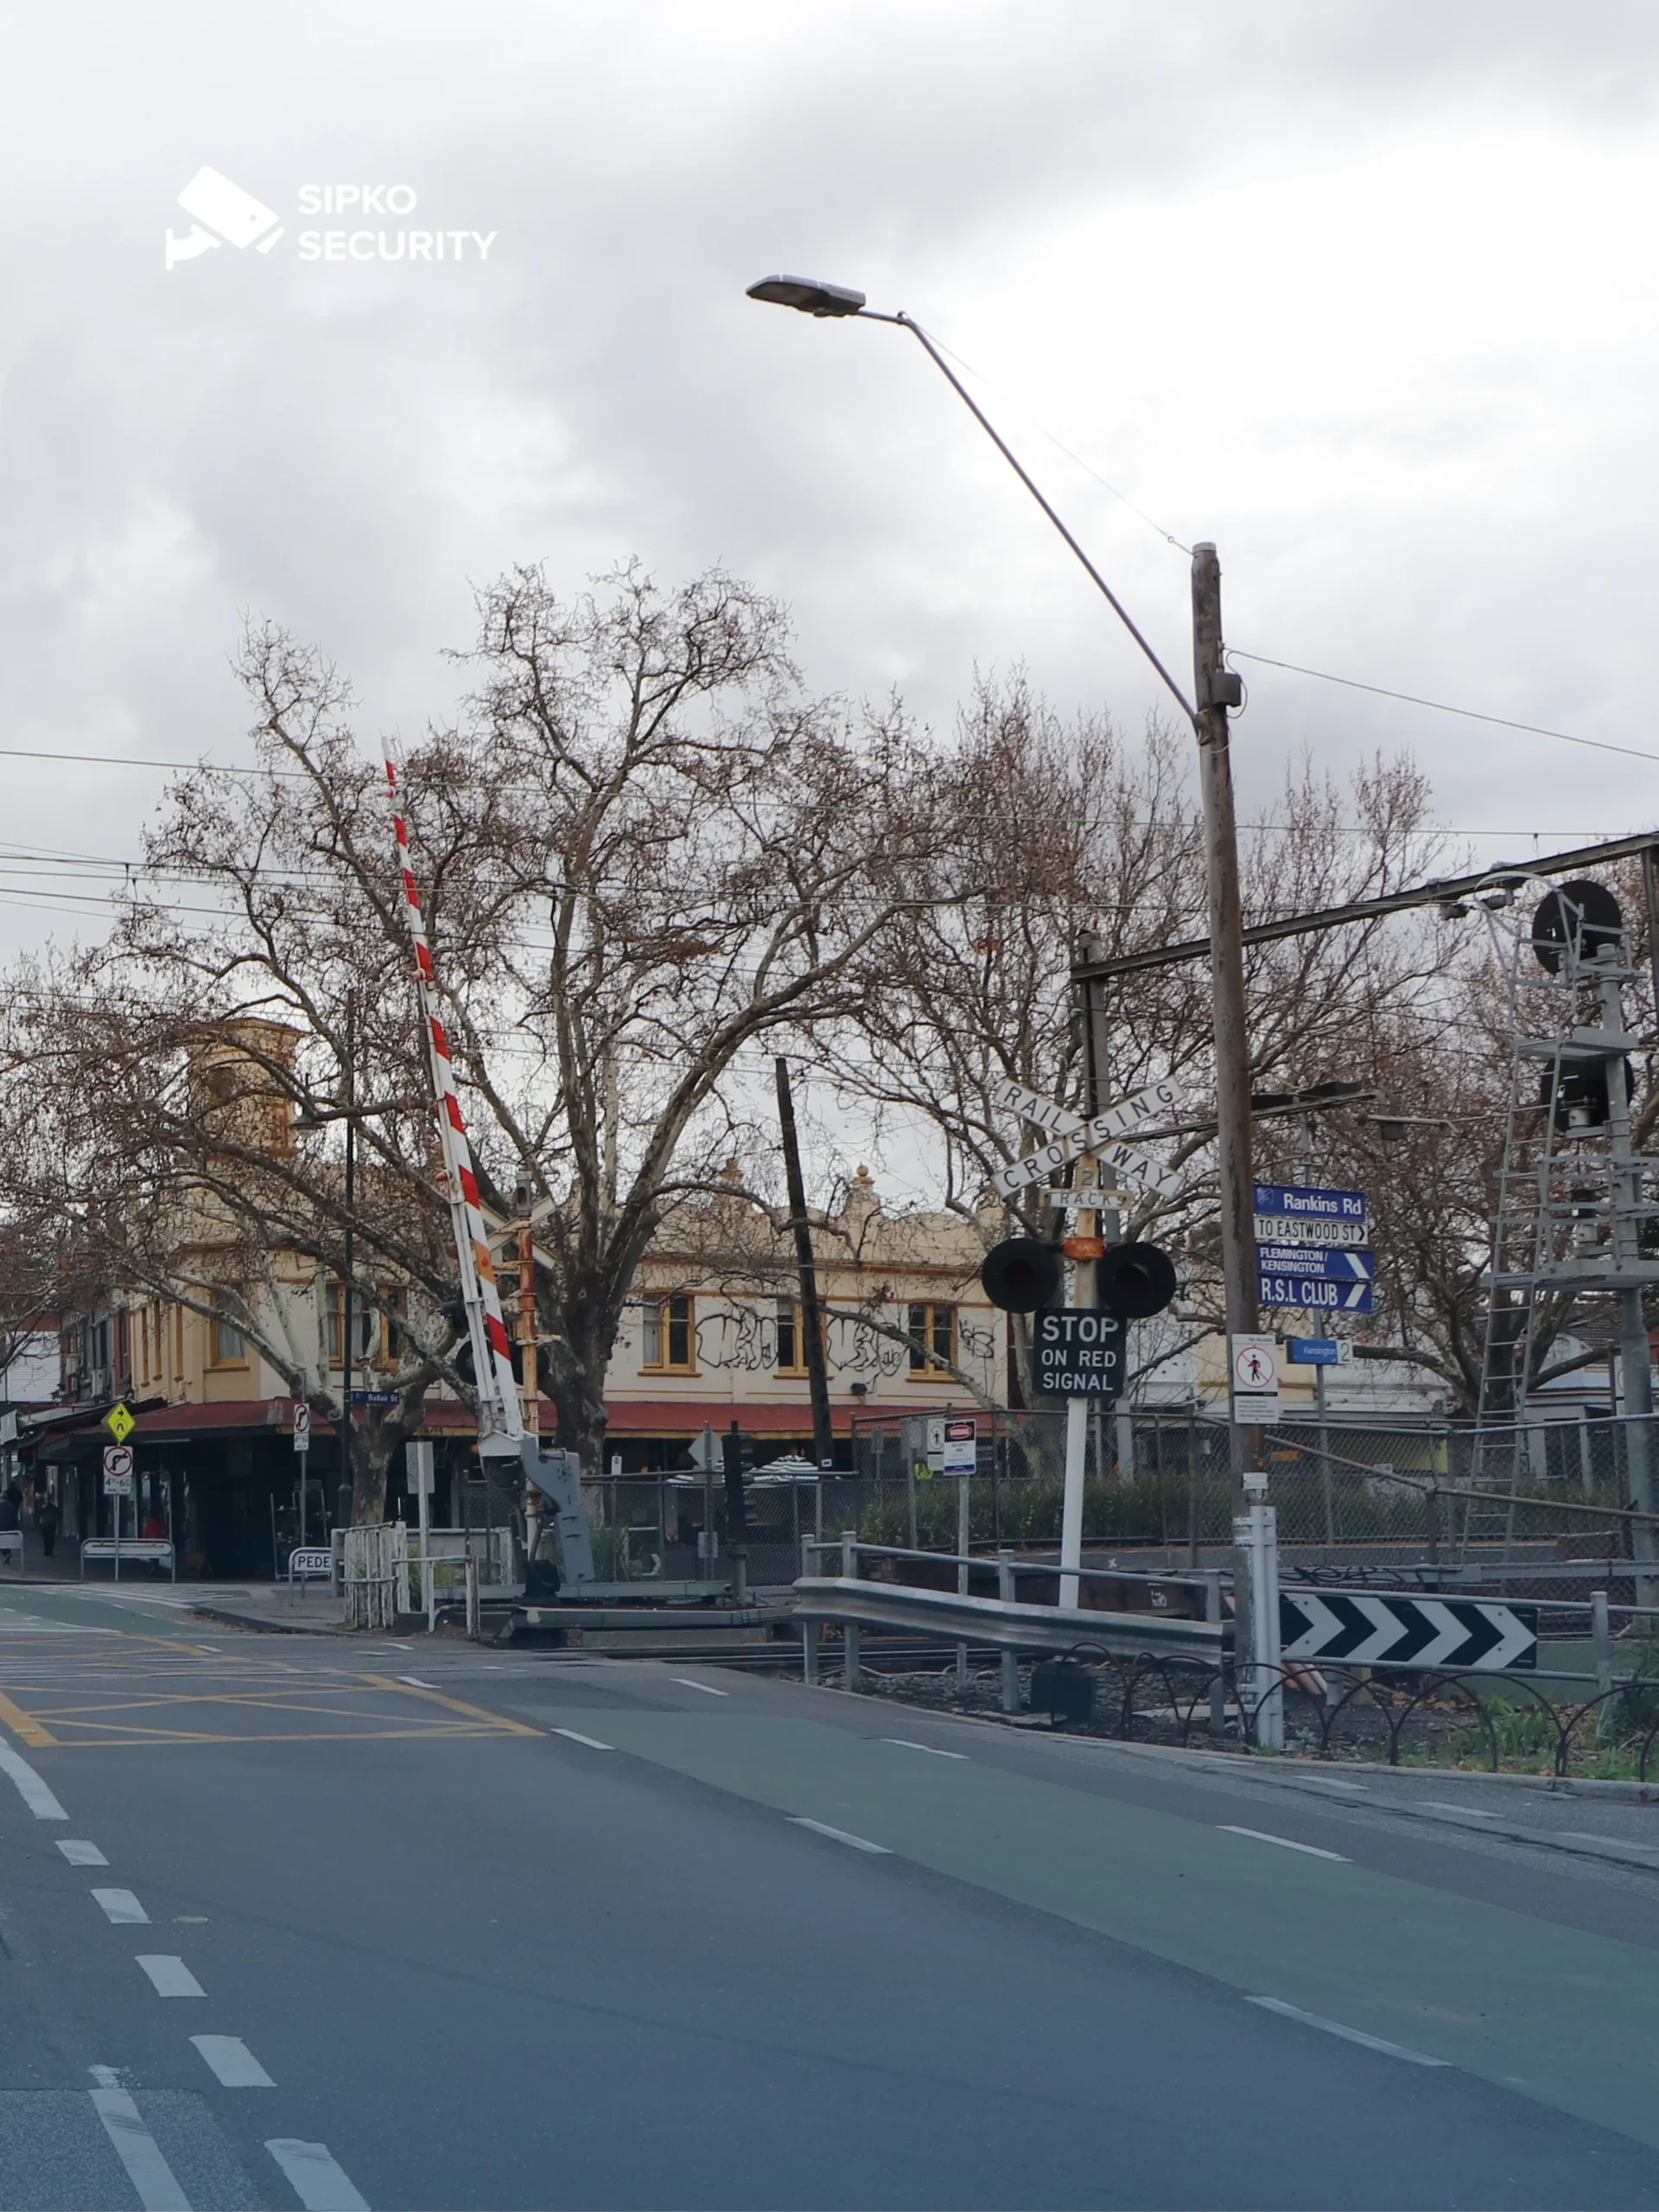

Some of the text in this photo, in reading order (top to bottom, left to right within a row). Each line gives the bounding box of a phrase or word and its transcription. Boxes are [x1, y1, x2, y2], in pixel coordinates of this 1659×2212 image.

[1081, 1170, 1094, 1187] 2
[1058, 1192, 1126, 1207] RACKS
[1283, 1192, 1363, 1215] Rankins Rd
[1259, 1219, 1355, 1241] TO EASTWOOD ST
[1261, 1260, 1325, 1274] KENSINGTON
[1301, 1281, 1338, 1306] CLUB
[1041, 1315, 1119, 1343] STOP
[1041, 1349, 1117, 1368] ON RED
[1340, 1342, 1351, 1362] 2
[1042, 1371, 1114, 1391] SIGNAL
[390, 1394, 398, 1403] St
